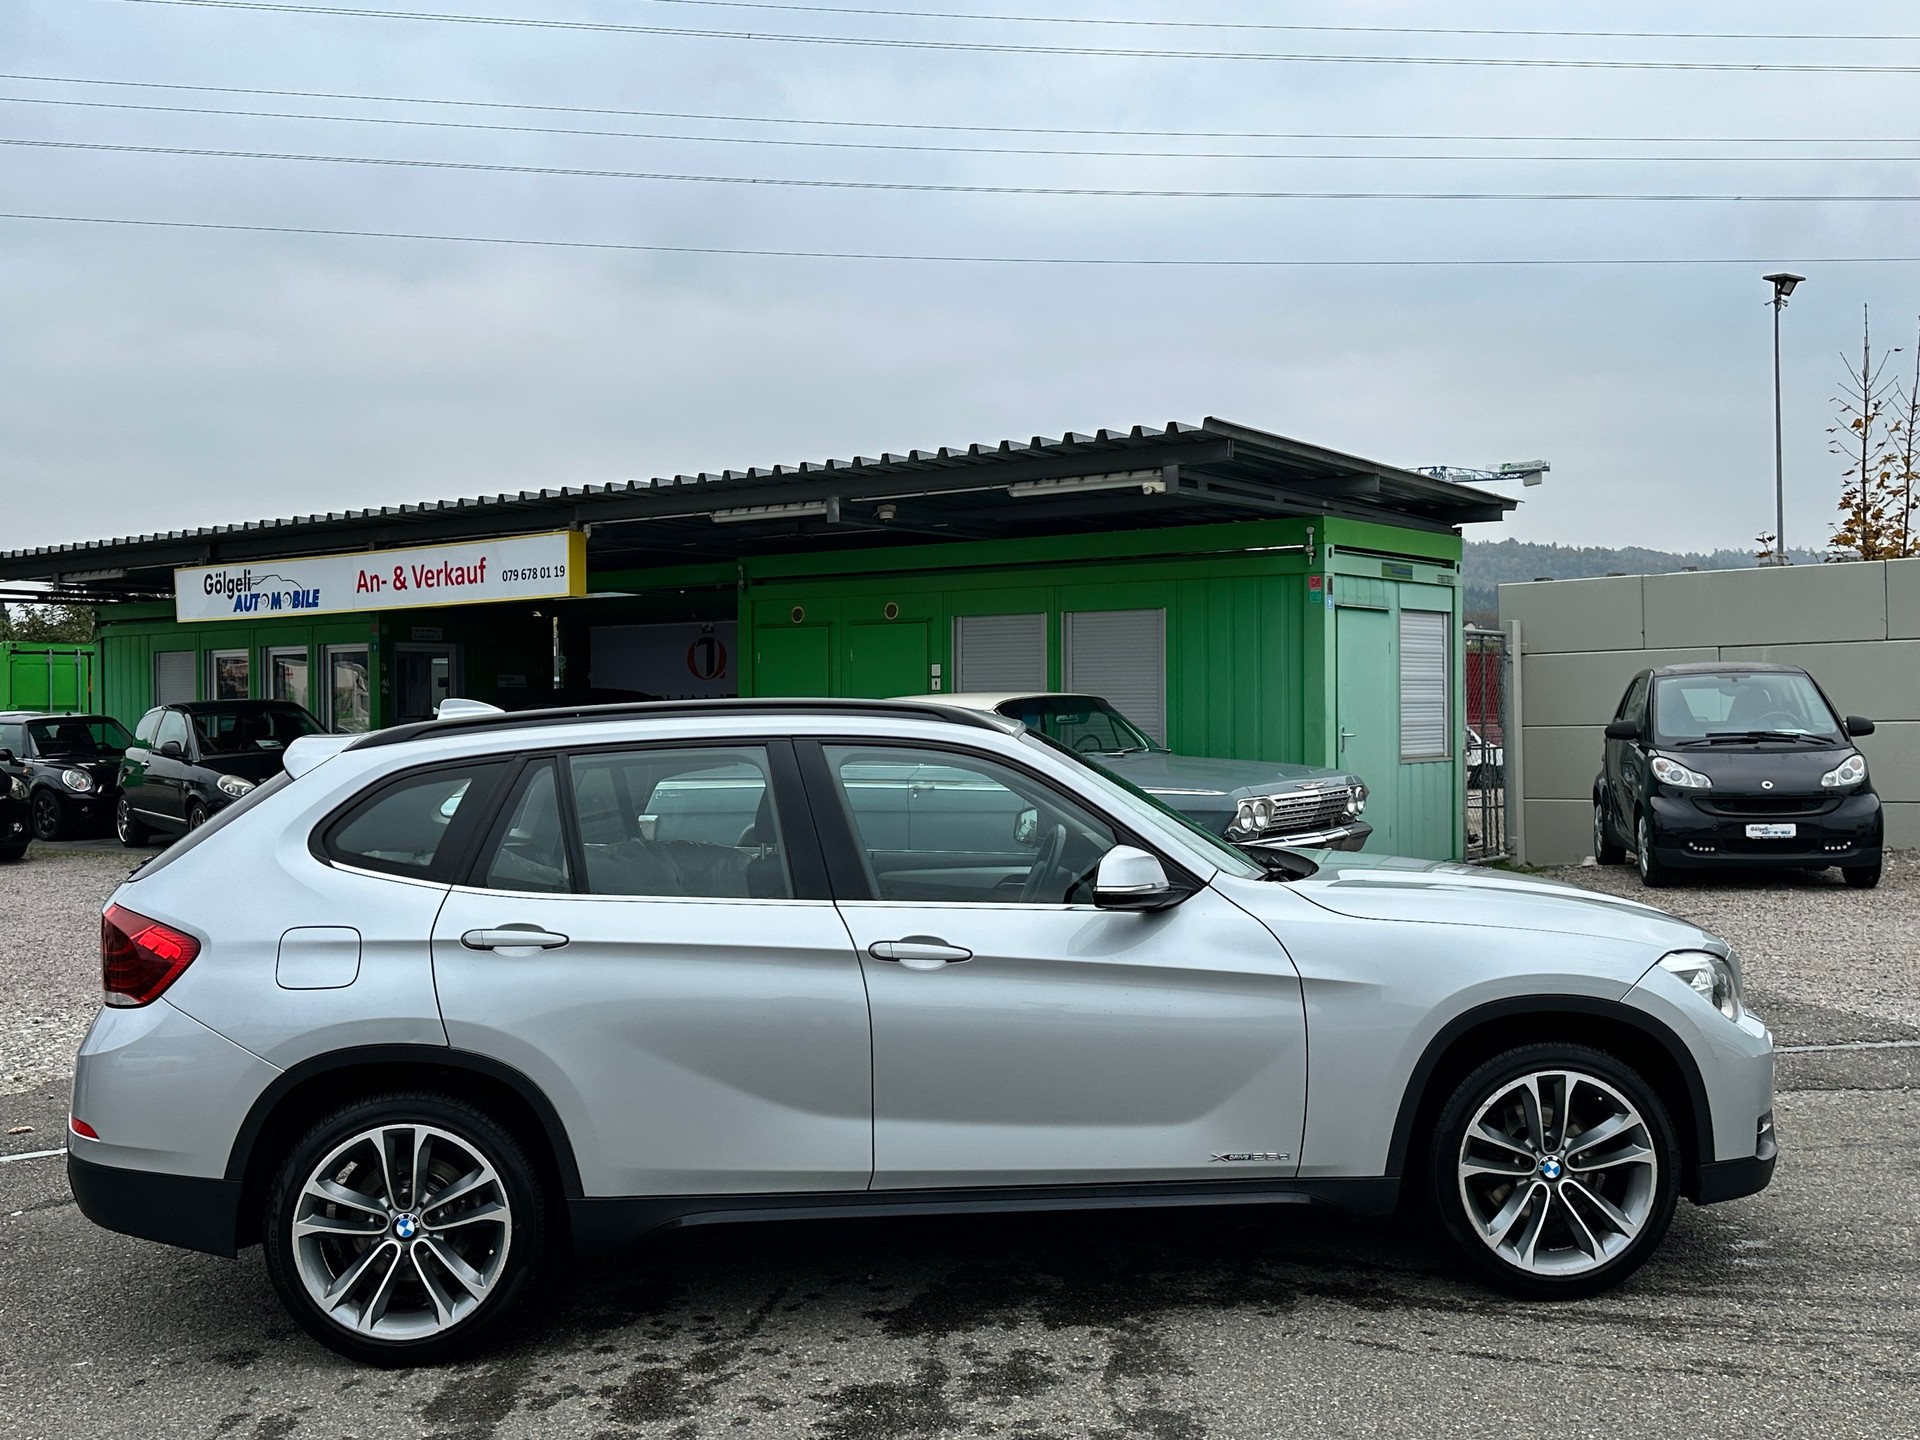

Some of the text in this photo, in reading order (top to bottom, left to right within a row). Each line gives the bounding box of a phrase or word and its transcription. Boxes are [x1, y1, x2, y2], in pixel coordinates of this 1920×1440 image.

[203, 569, 251, 600] Gölgeli
[356, 557, 487, 594] An- & Verkauf
[502, 565, 566, 582] 079 678 01 19
